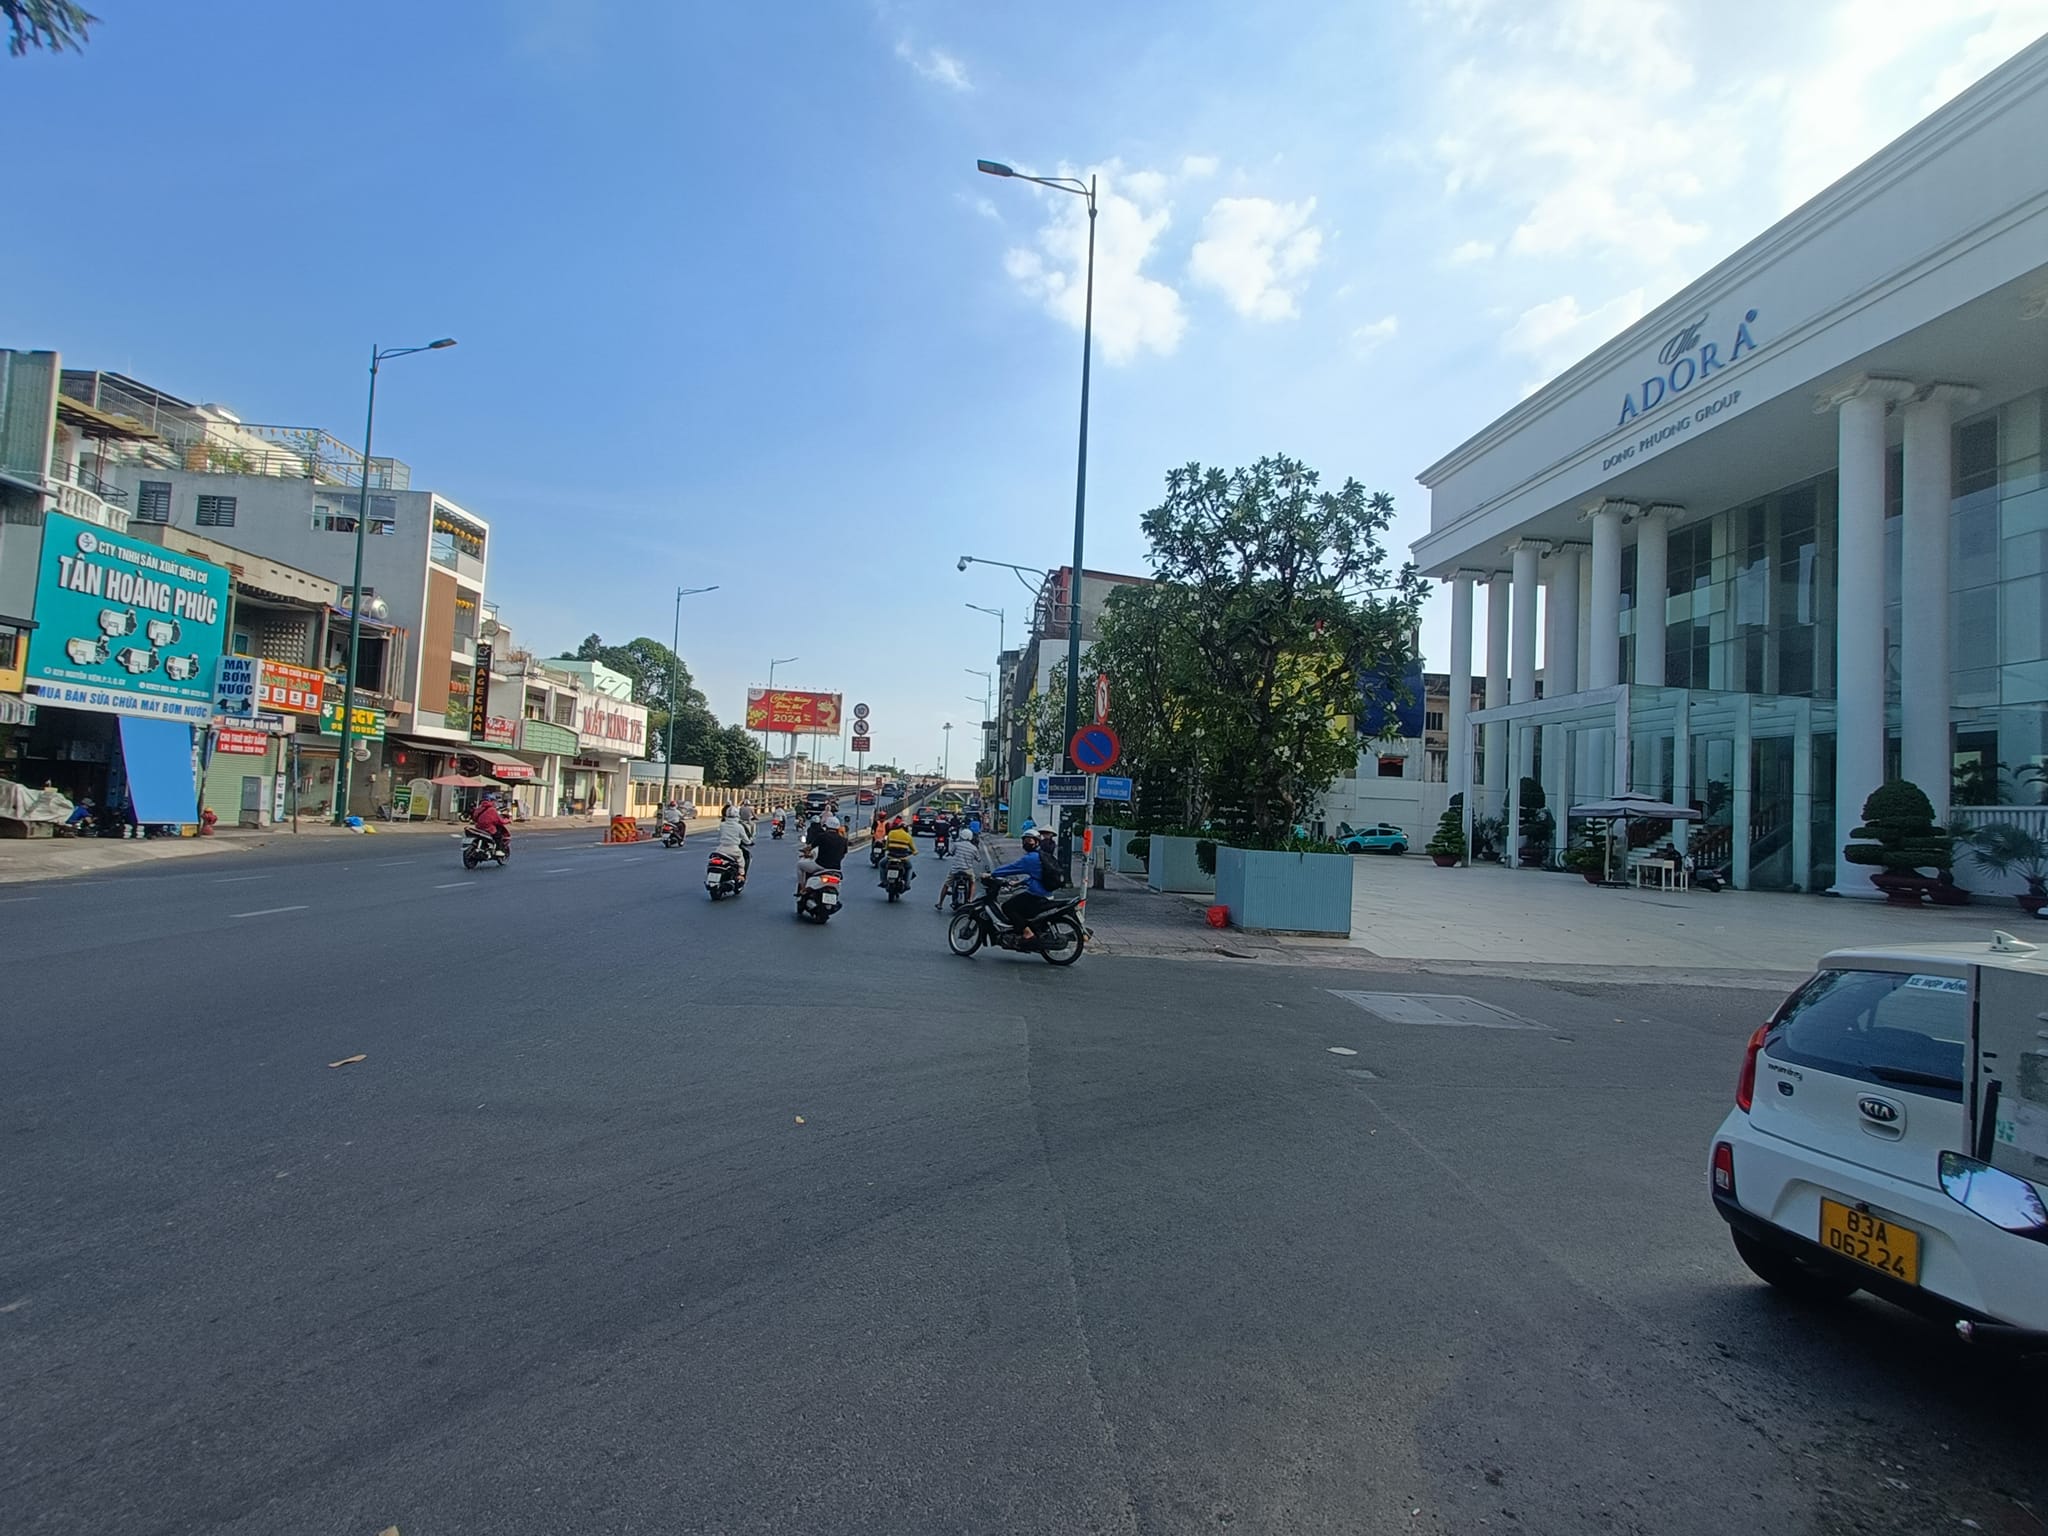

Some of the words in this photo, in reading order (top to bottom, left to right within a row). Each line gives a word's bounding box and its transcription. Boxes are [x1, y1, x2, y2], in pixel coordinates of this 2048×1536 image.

[1617, 309, 1758, 426] ADORA
[1602, 446, 1635, 472] DONG
[1638, 416, 1691, 453] PHUONG
[1694, 390, 1742, 423] GROUP
[98, 541, 118, 557] CTY
[117, 546, 141, 567] TNHH
[58, 553, 103, 597] TÂN
[105, 570, 172, 614] HOÀNG
[173, 590, 218, 625] PHÚC
[37, 685, 61, 700] MUA
[773, 714, 802, 723] 2024
[1863, 1101, 1891, 1119] KIA
[1847, 1210, 1888, 1245] 83A
[1830, 1228, 1905, 1277] 062.24
